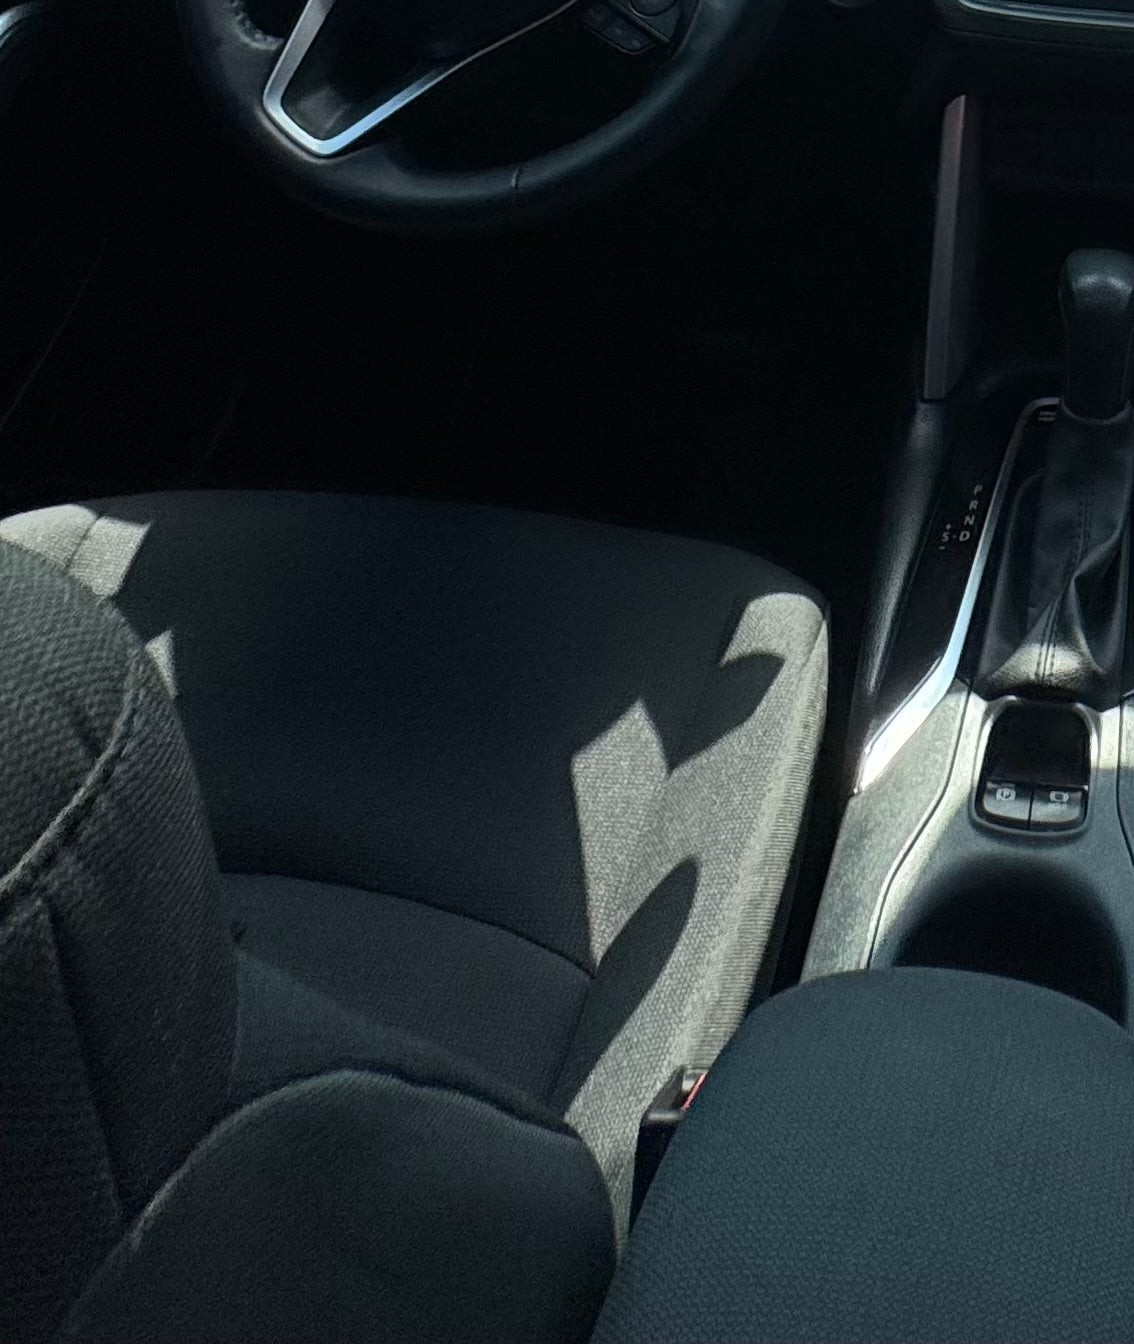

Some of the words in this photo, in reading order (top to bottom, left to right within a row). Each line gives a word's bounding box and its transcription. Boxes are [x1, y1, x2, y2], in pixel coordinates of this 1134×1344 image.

[973, 484, 984, 496] P
[968, 499, 979, 511] R
[963, 514, 976, 526] N
[941, 531, 951, 543] S
[958, 530, 971, 542] D
